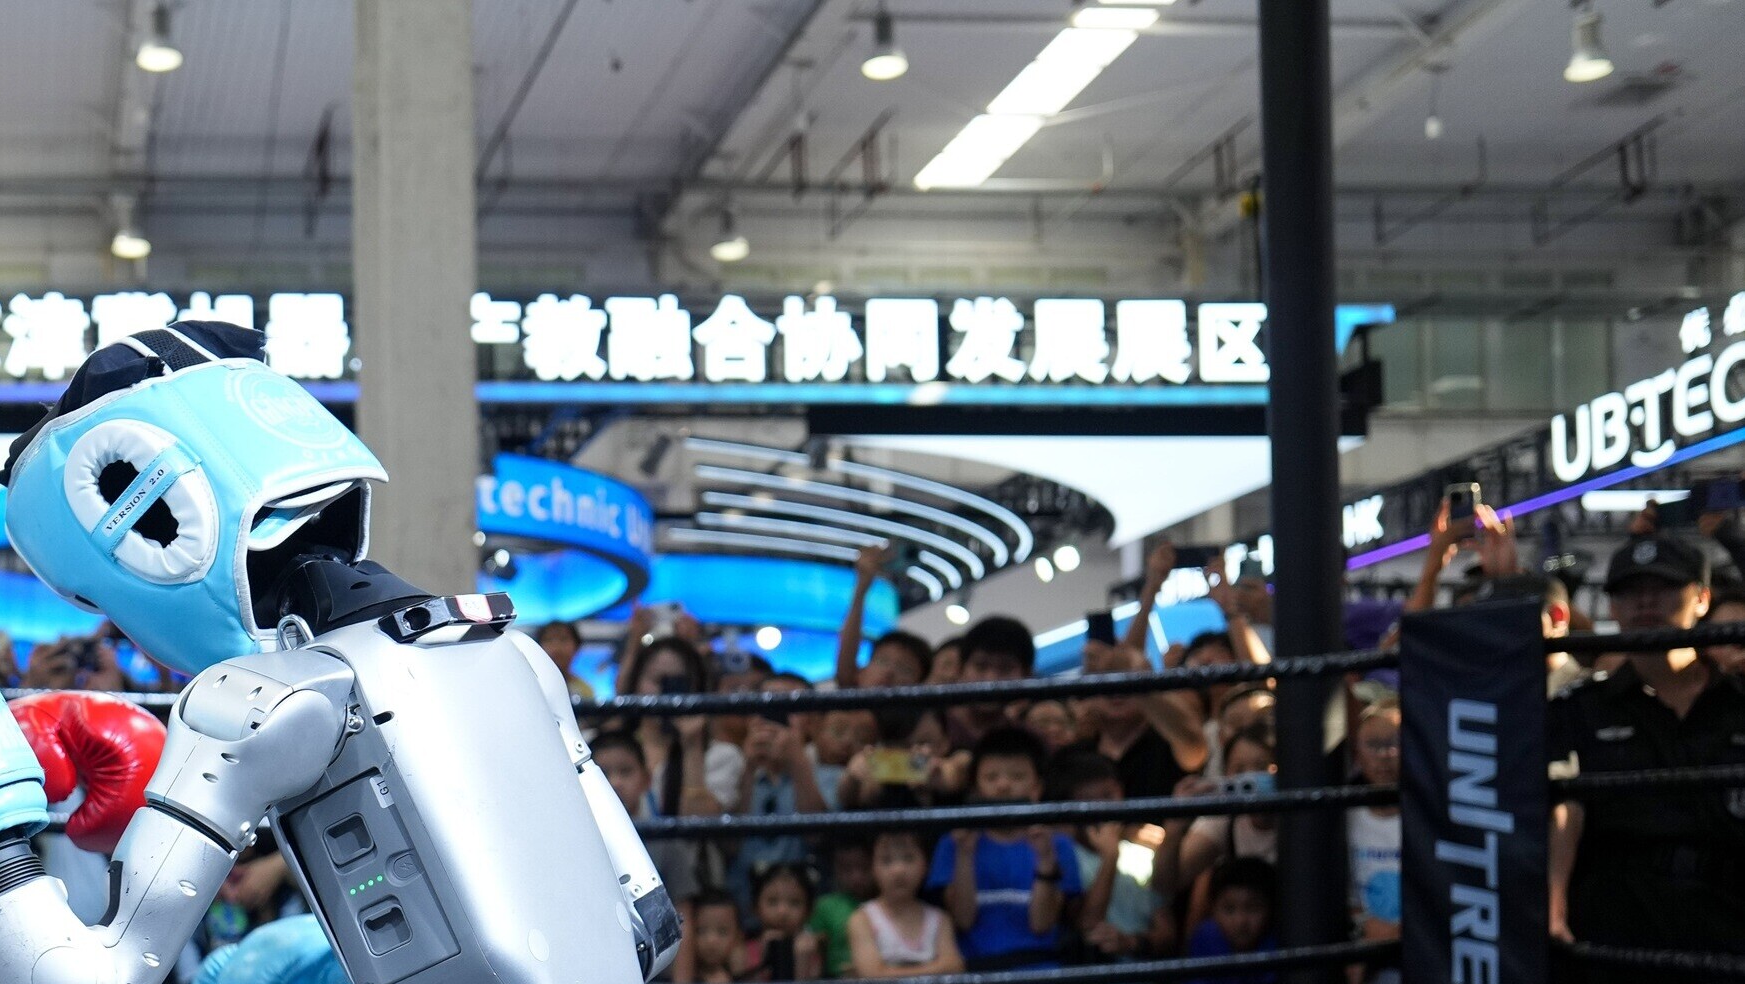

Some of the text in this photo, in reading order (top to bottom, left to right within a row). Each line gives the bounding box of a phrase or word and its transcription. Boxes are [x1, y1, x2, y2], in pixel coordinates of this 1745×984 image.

[106, 469, 165, 531] VERSION 2.0
[376, 780, 390, 796] G1
